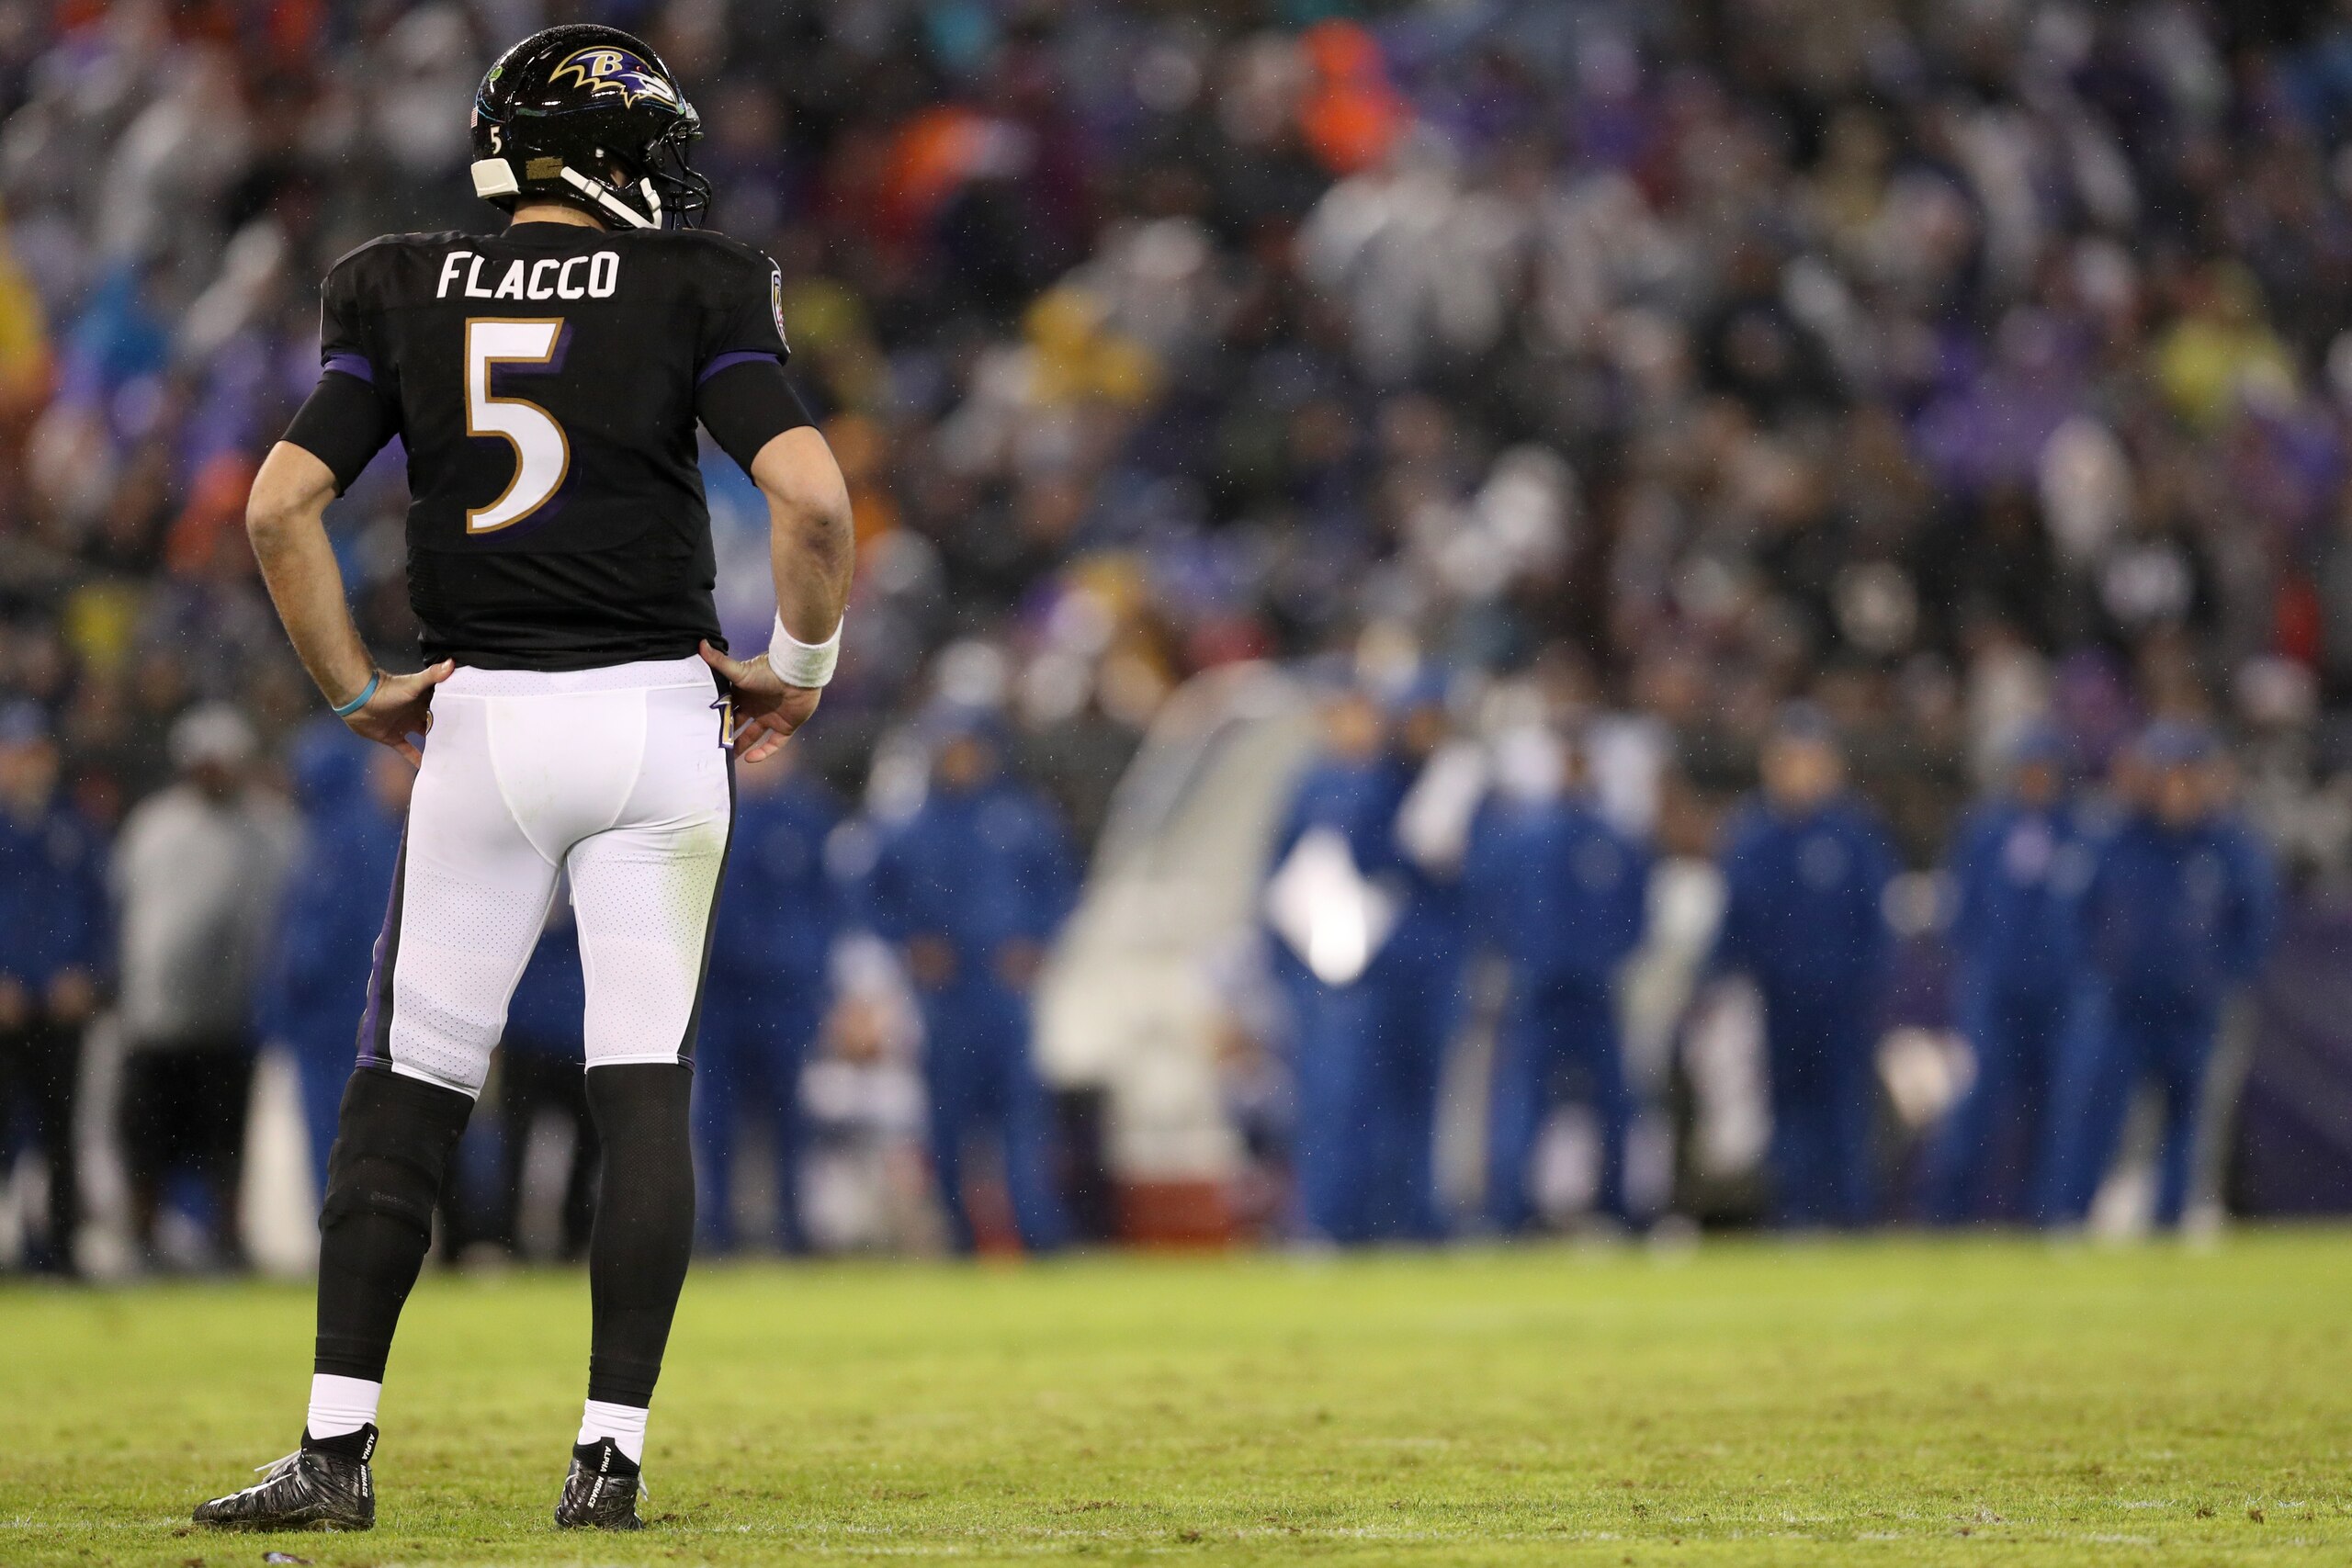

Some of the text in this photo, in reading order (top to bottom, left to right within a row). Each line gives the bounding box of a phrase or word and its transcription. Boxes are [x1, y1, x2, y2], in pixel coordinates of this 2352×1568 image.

[588, 51, 624, 77] B
[489, 125, 503, 154] 5
[436, 251, 620, 300] FLACCO
[464, 317, 571, 534] 5
[360, 1433, 375, 1498] ALPHA MENACE
[587, 1445, 612, 1509] ALPHA MENACE
